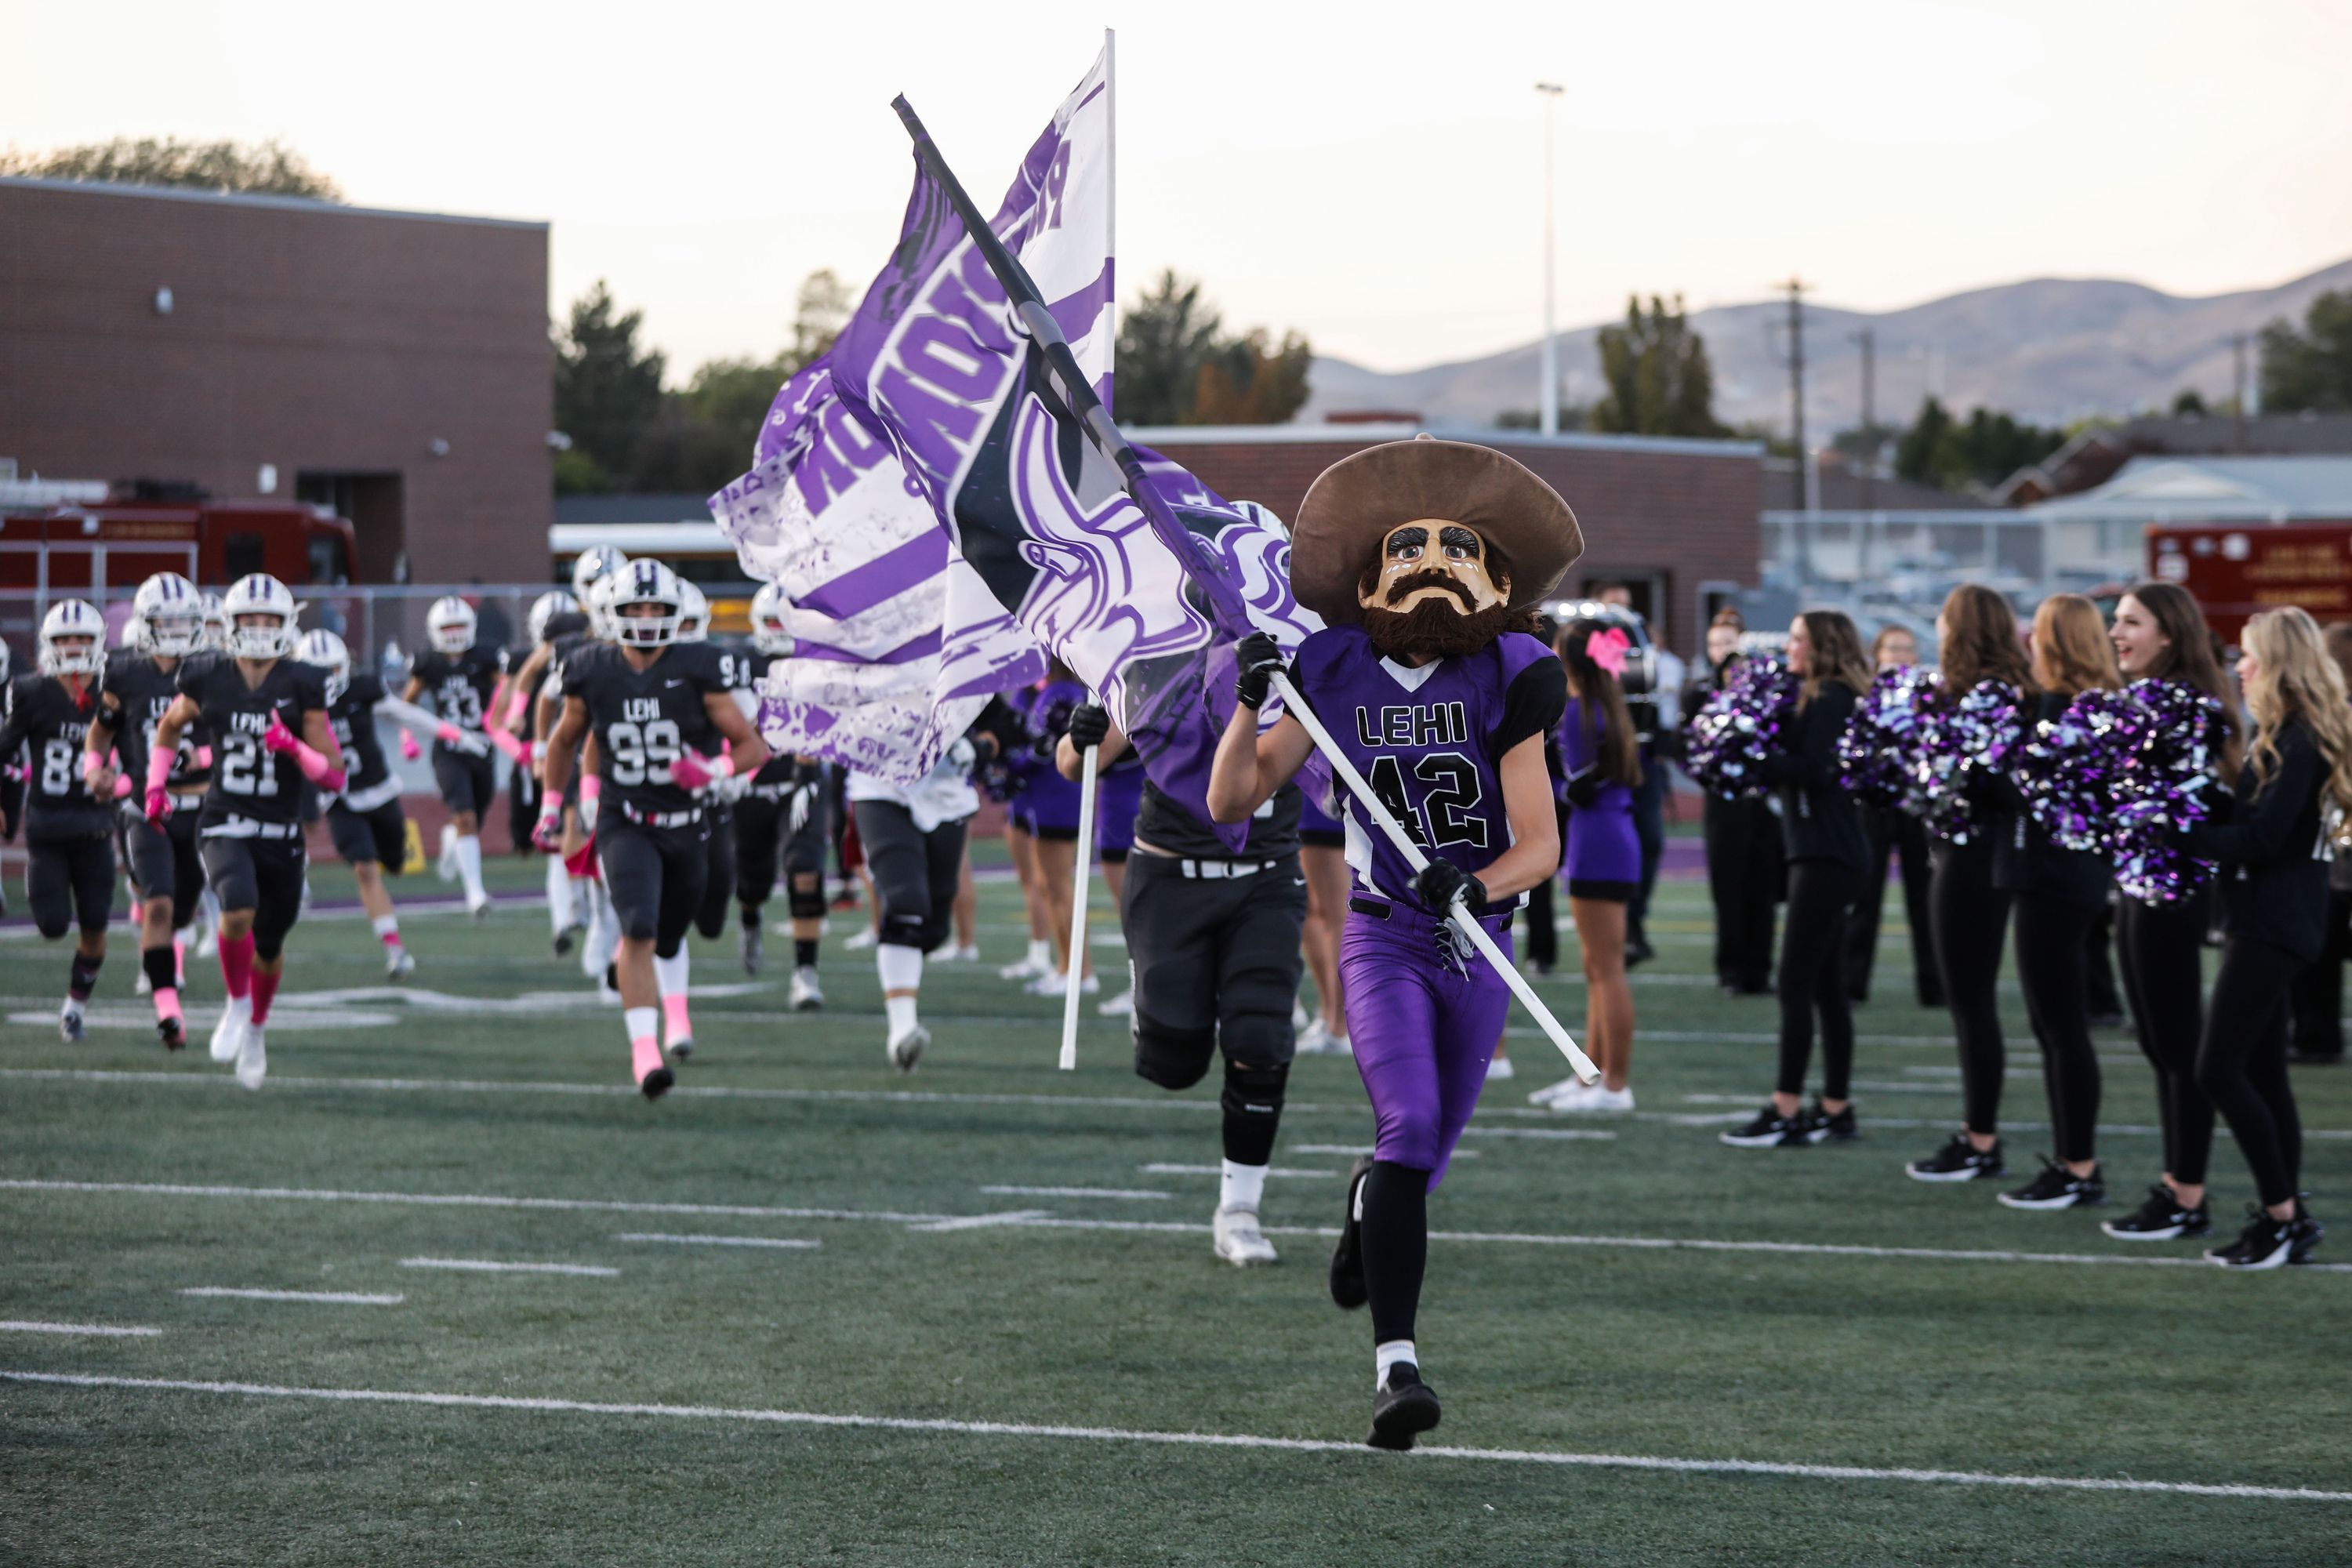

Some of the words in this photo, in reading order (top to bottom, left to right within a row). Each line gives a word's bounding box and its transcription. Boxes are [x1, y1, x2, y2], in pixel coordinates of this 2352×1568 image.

[622, 697, 660, 721] LEHI
[1356, 701, 1468, 747] LEHI
[223, 731, 278, 796] 21
[608, 719, 681, 786] 99
[1370, 751, 1489, 849] 42
